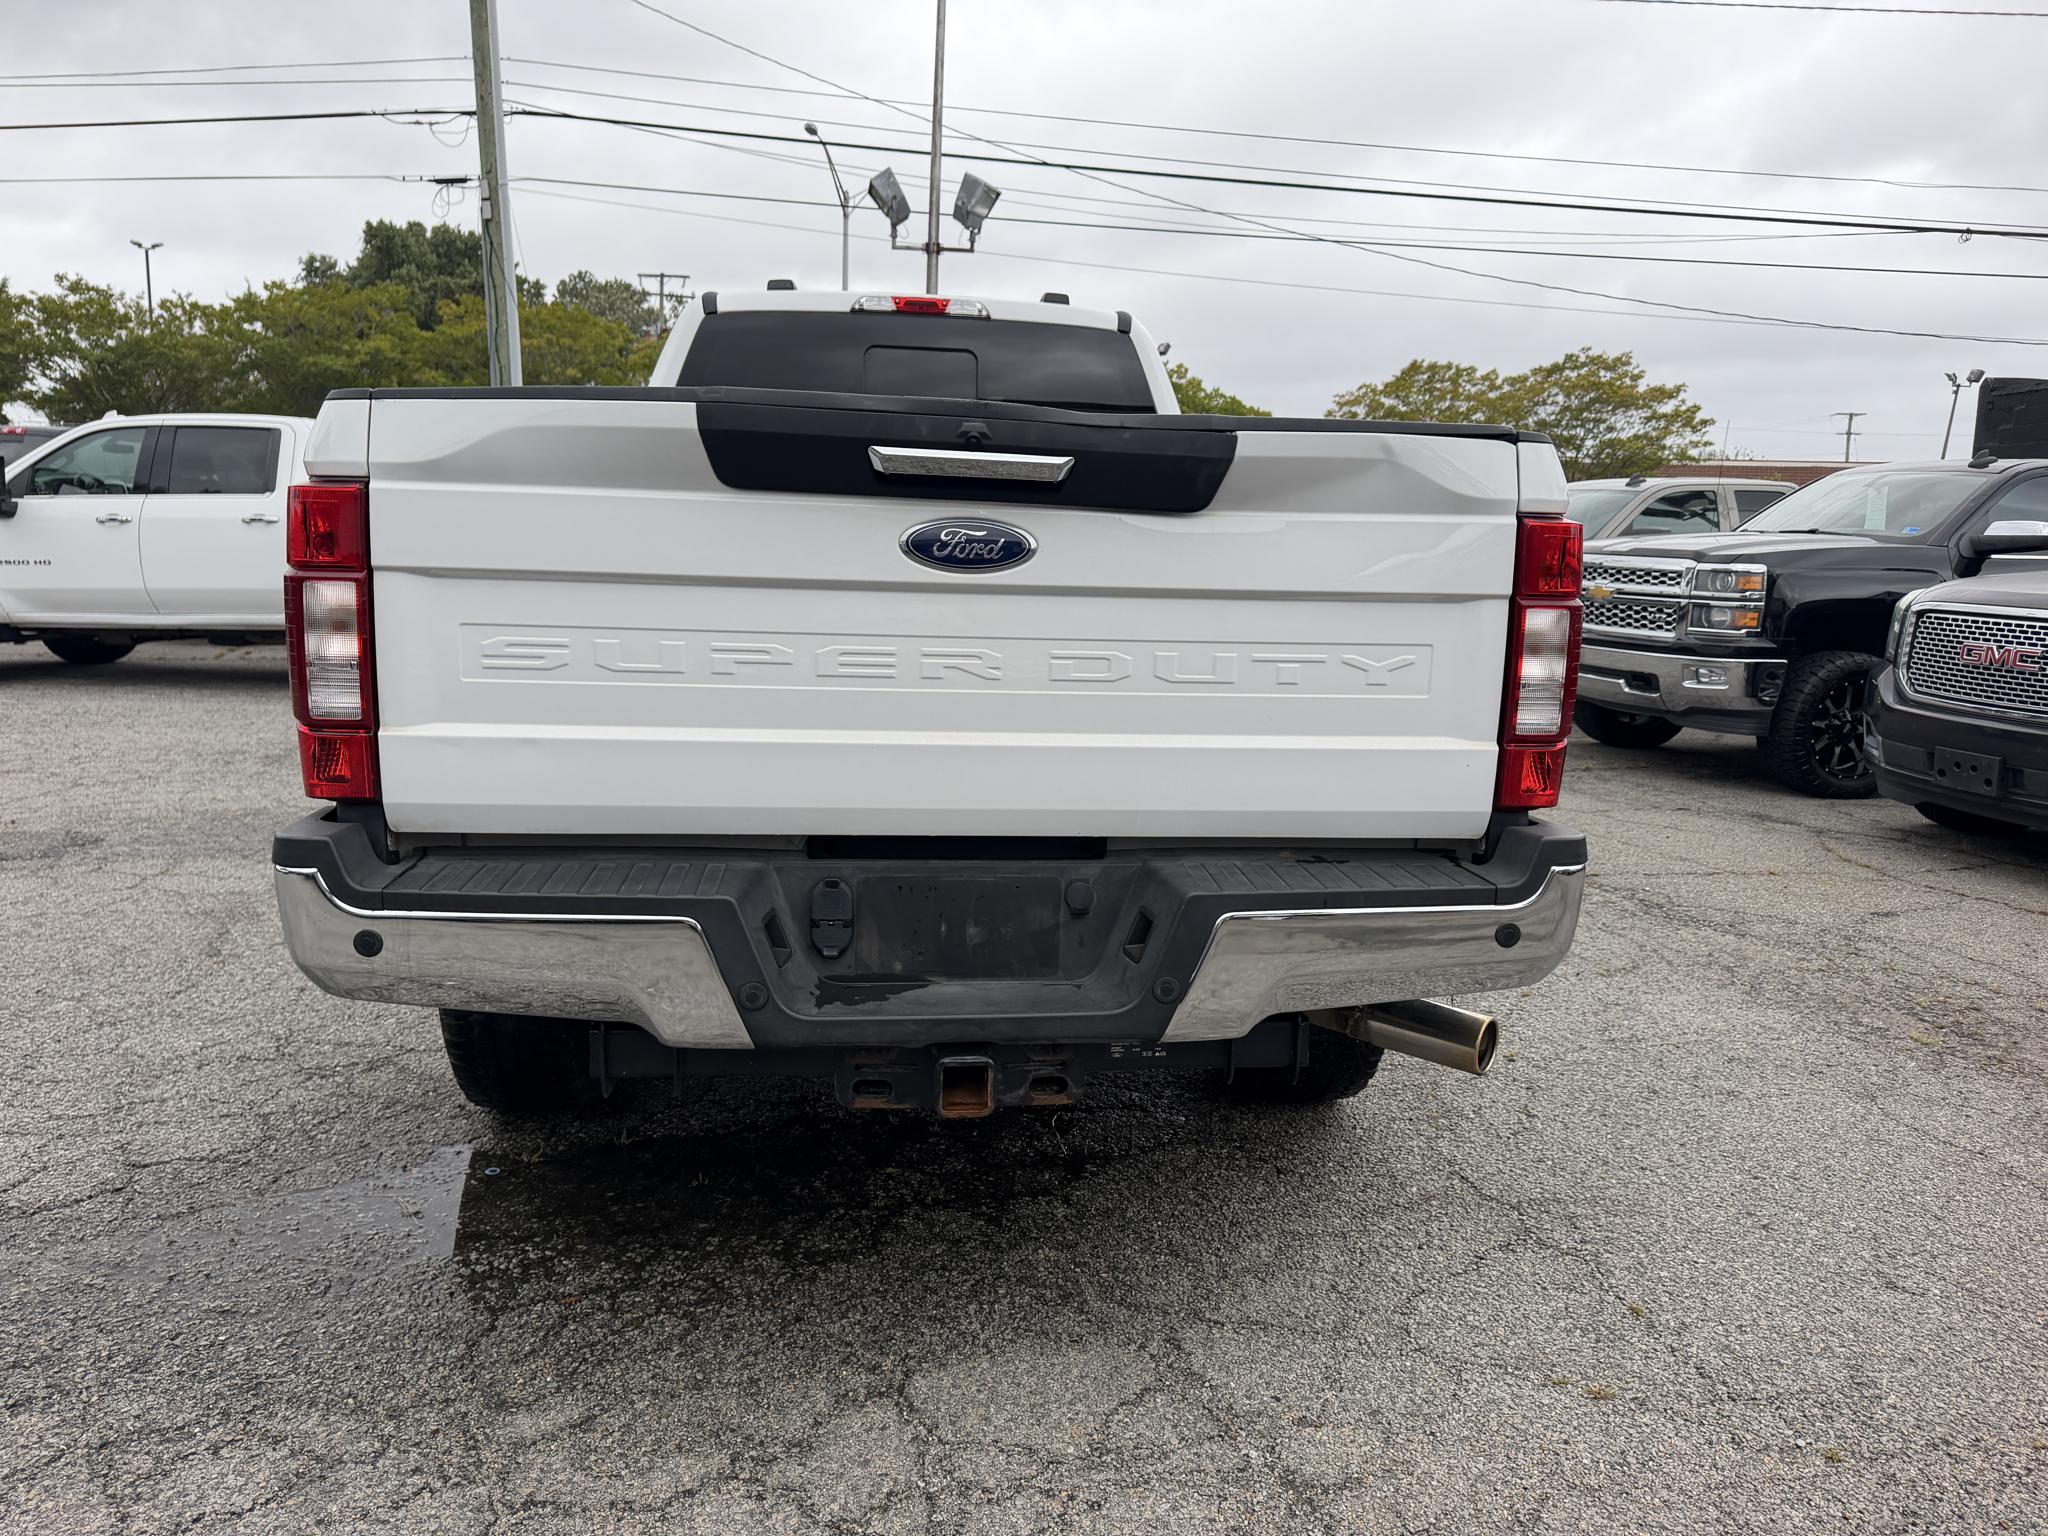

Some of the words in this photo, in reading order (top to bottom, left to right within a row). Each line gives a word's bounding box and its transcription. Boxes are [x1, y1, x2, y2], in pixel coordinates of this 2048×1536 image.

[932, 528, 1005, 559] Ford
[481, 636, 1003, 681] SUPER
[1048, 649, 1417, 687] DUTY
[1960, 642, 2042, 671] GMC
